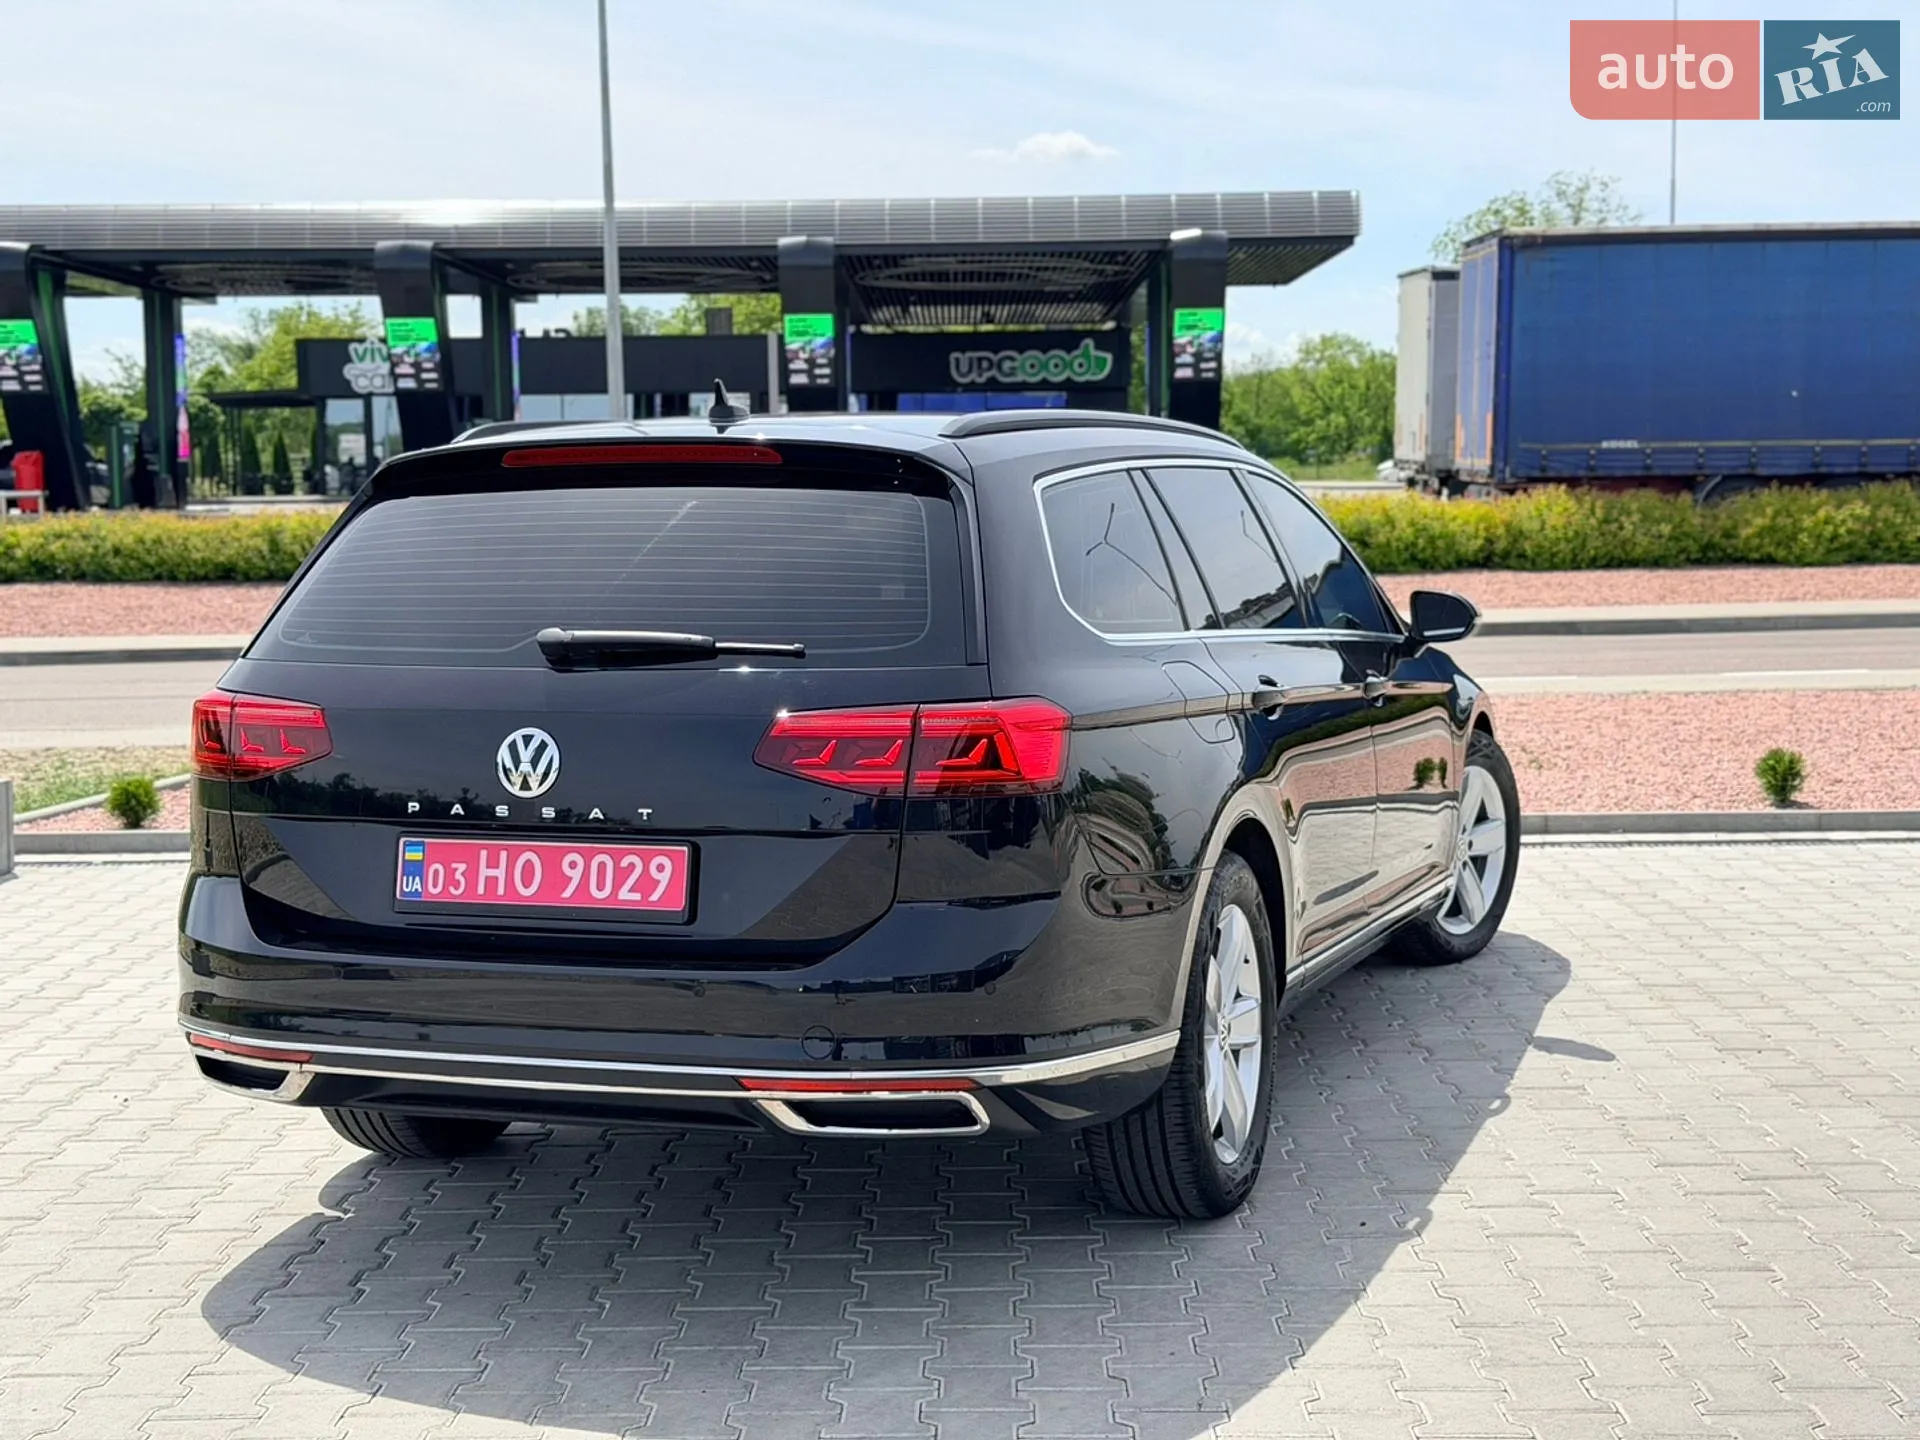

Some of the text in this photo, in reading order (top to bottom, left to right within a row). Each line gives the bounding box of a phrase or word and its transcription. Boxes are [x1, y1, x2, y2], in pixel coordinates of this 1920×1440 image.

[351, 341, 389, 363] viv
[407, 802, 652, 820] PASSAT
[402, 875, 423, 893] UA
[427, 848, 674, 902] 03 HO 9029
